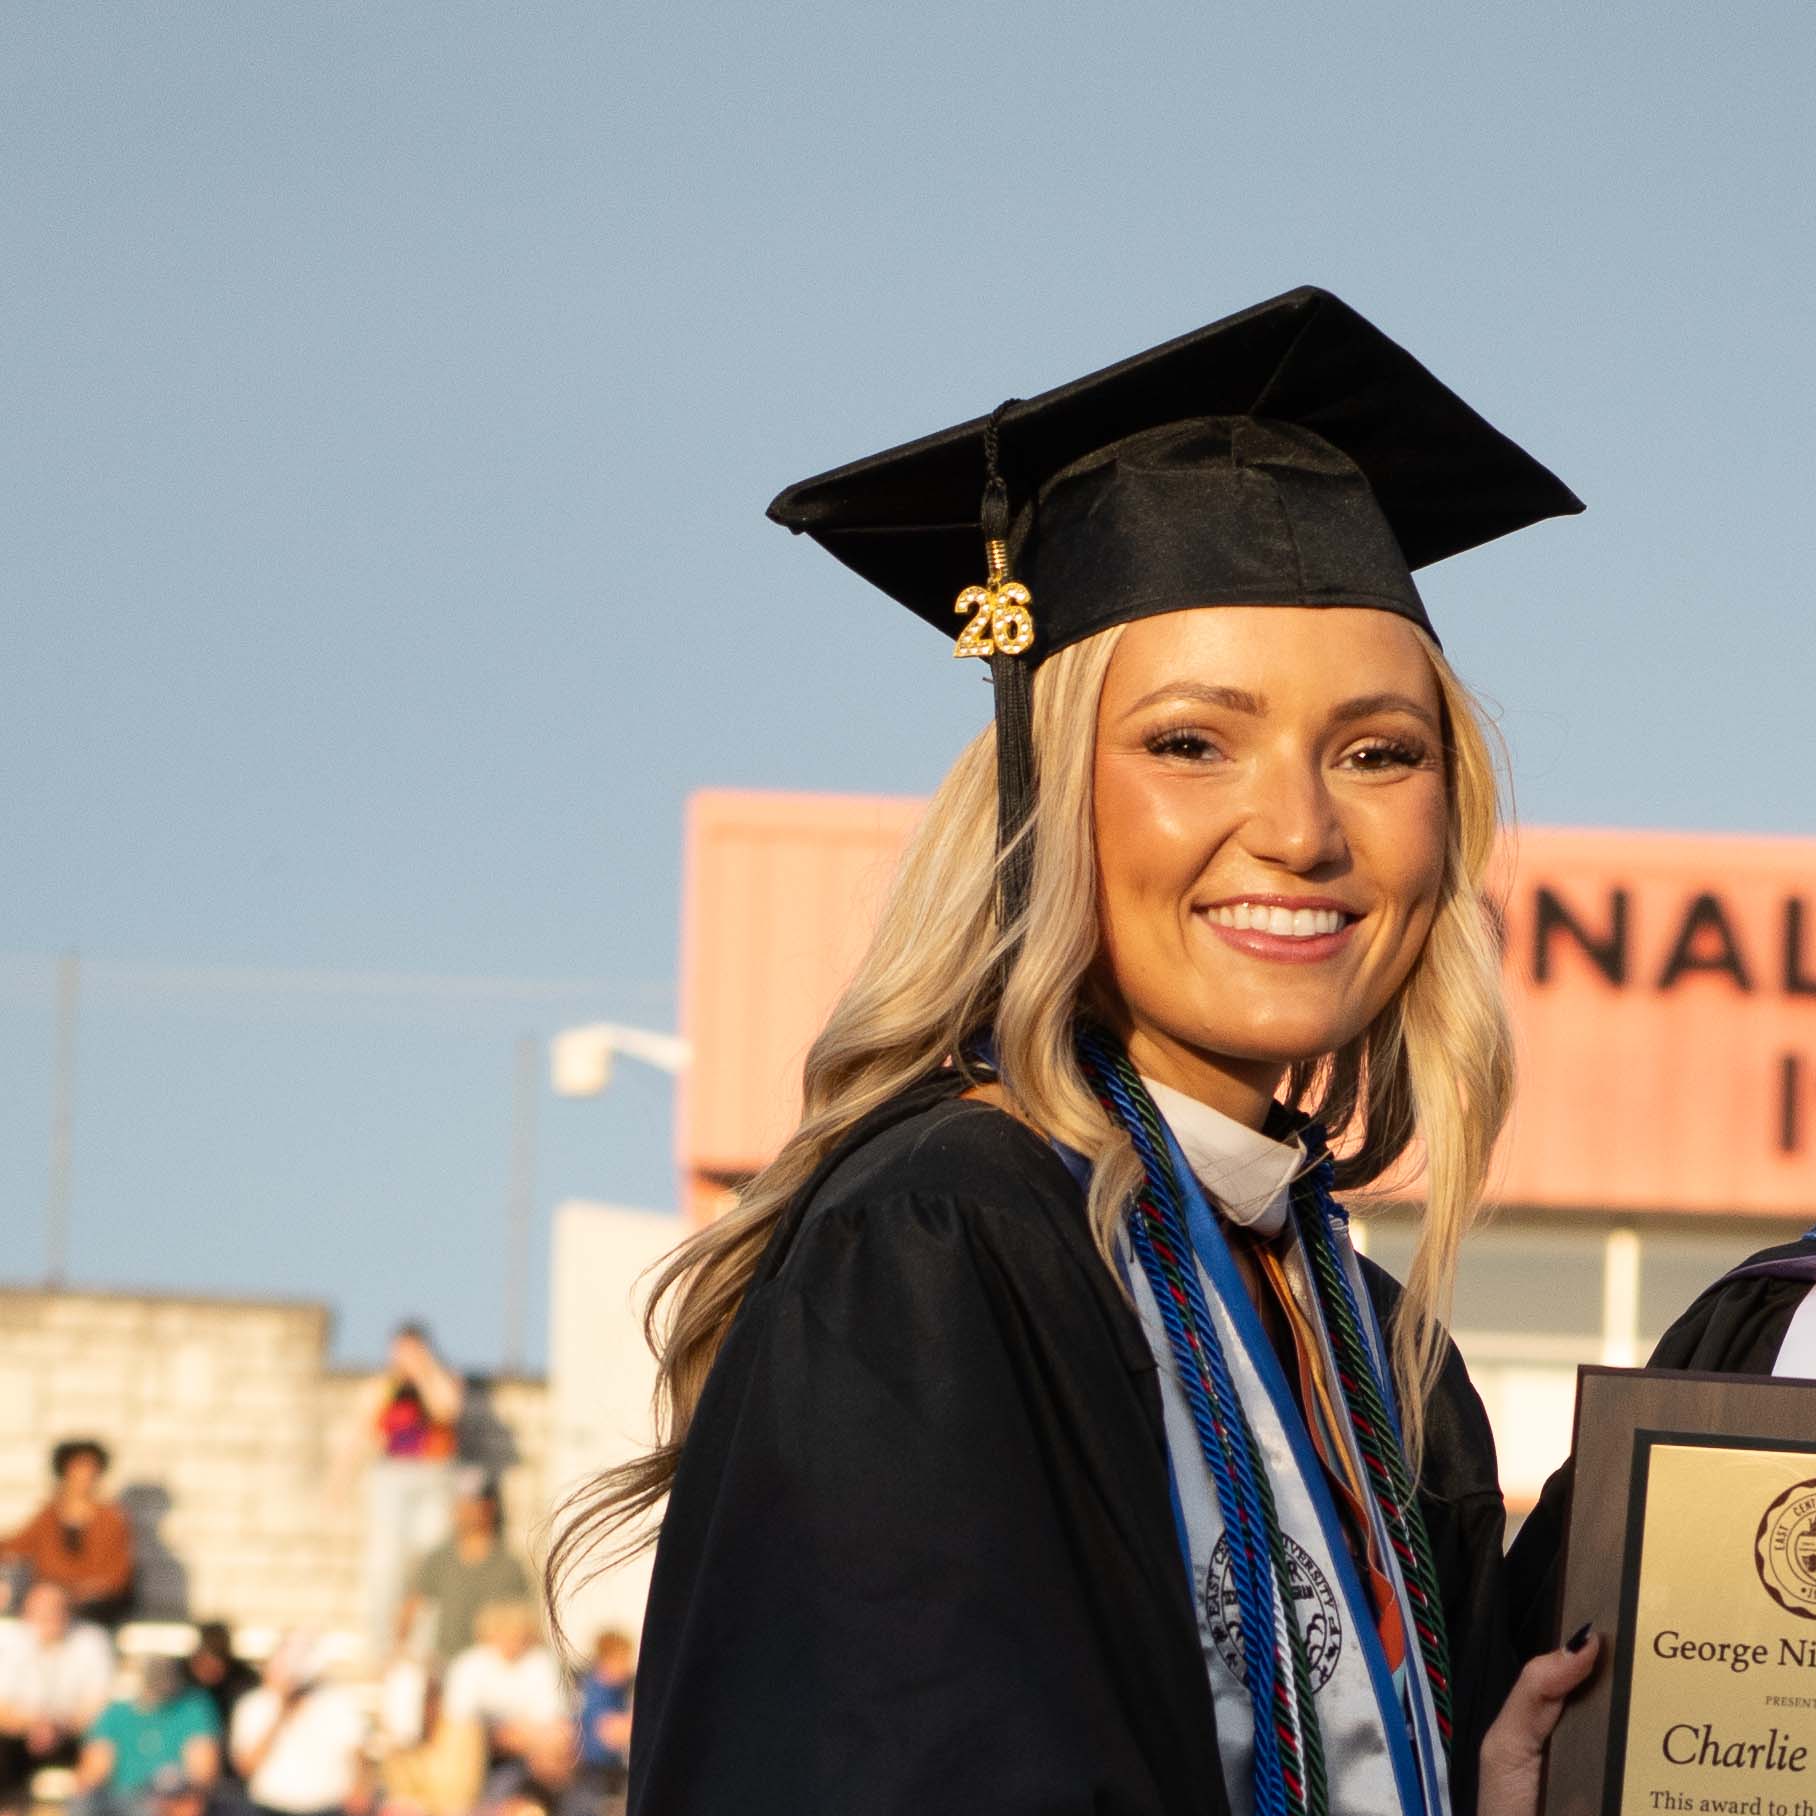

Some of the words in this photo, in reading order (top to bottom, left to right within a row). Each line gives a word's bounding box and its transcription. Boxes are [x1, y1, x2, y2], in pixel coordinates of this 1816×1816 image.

[953, 582, 1035, 658] 26
[1774, 1525, 1789, 1551] EAST
[1652, 1630, 1769, 1673] George
[1662, 1723, 1807, 1772] Charlie
[1650, 1790, 1694, 1812] This
[1699, 1796, 1762, 1816] award
[1767, 1800, 1788, 1816] to
